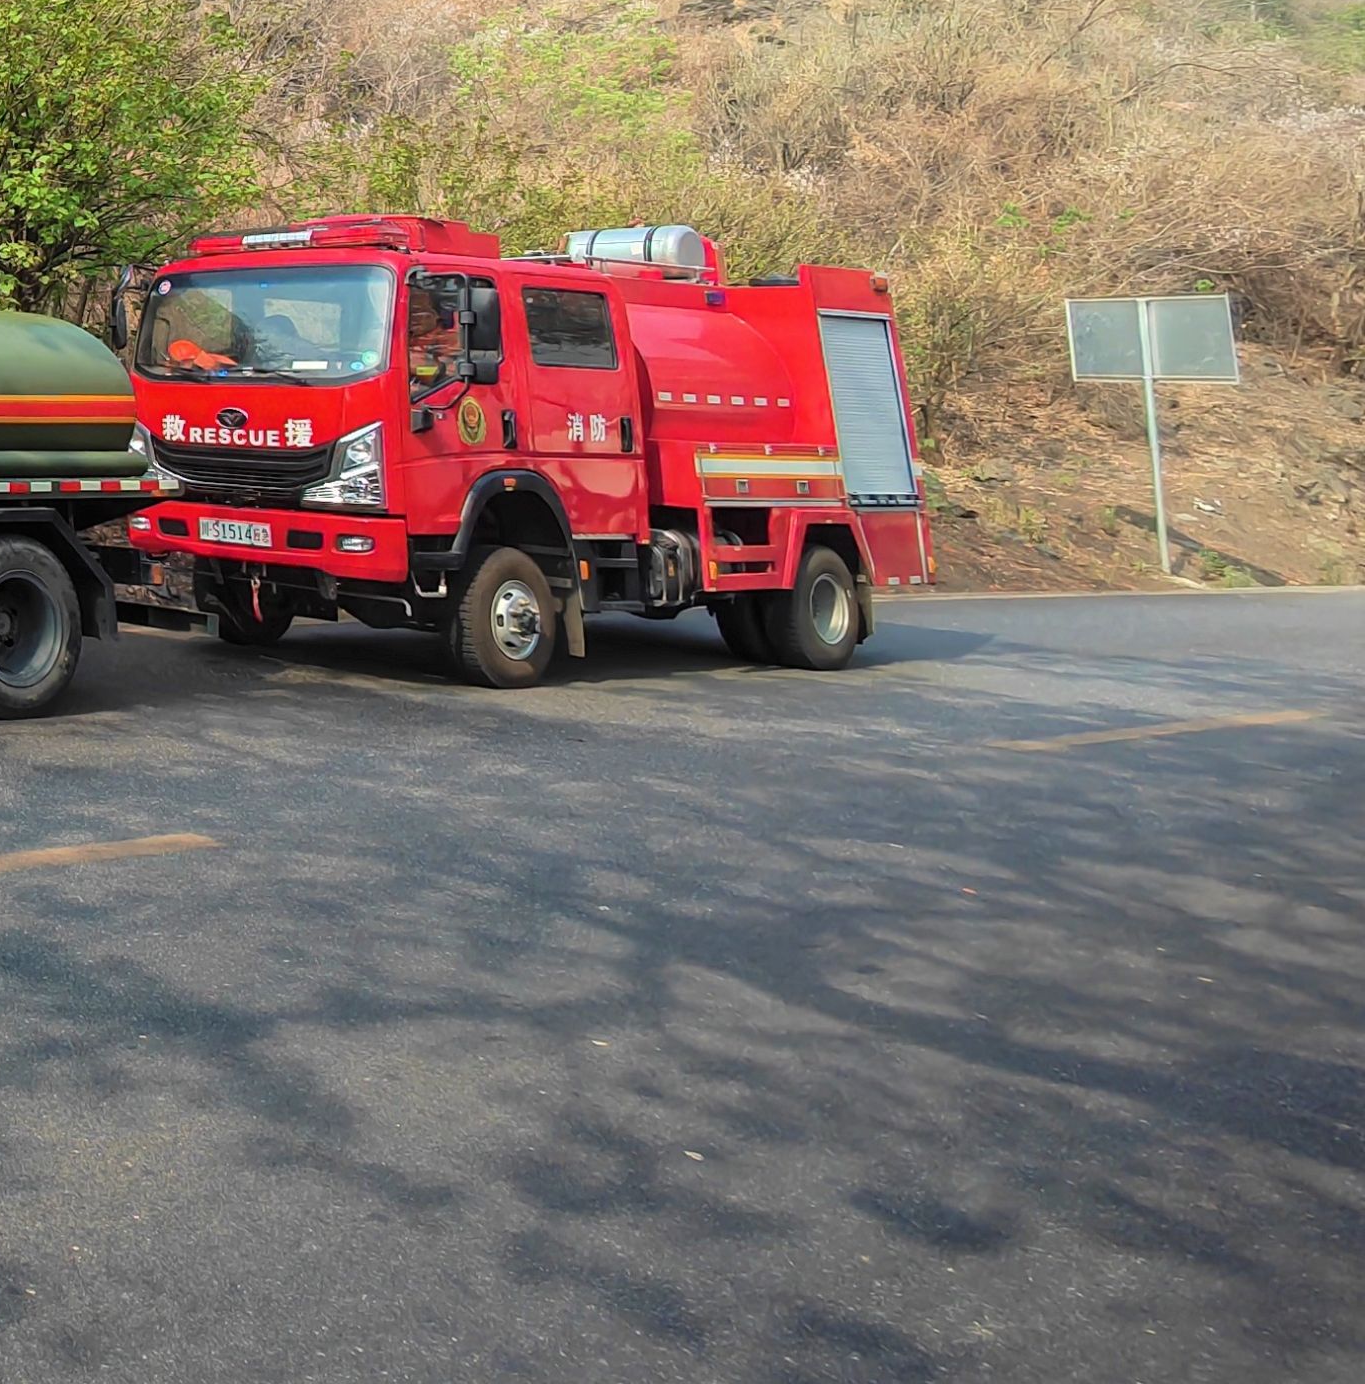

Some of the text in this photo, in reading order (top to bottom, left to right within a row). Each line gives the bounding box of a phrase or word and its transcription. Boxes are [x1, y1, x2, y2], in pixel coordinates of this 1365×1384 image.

[162, 414, 315, 447] 救 RESCUE 援
[566, 412, 606, 442] 消防
